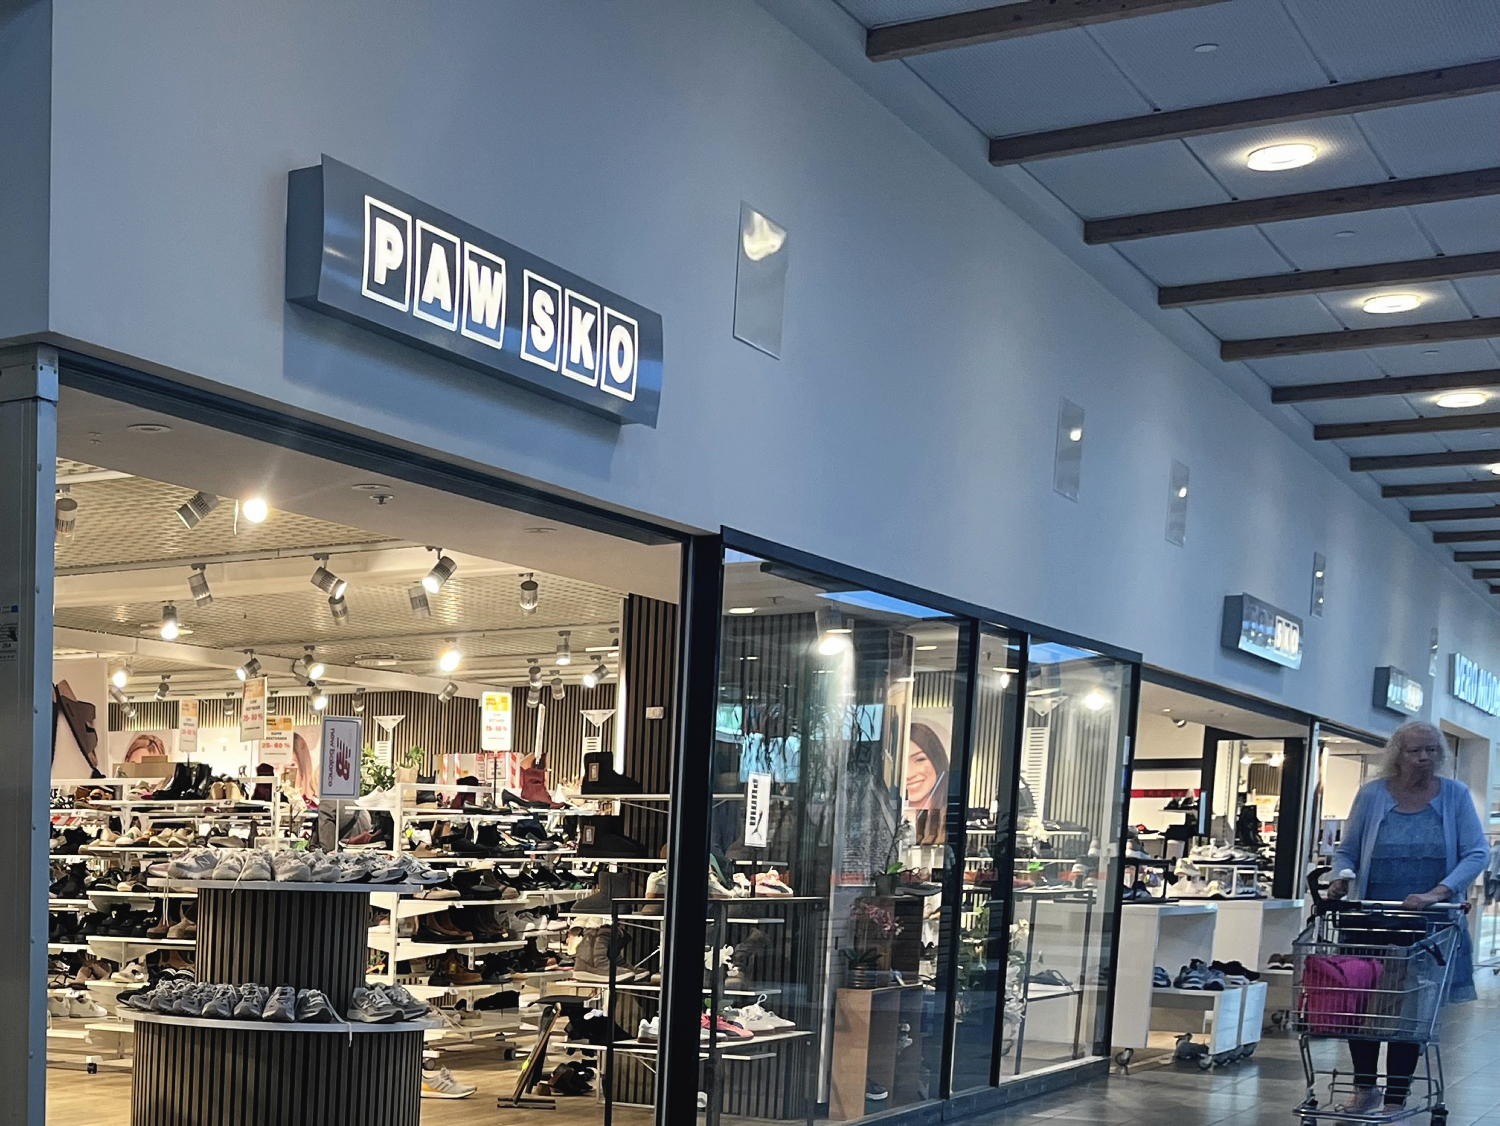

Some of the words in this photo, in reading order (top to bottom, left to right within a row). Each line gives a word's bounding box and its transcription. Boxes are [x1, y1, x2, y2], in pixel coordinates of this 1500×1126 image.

[372, 215, 503, 331] PAW
[528, 287, 635, 386] SKO
[1454, 652, 1478, 705] VERO
[328, 748, 336, 787] balance
